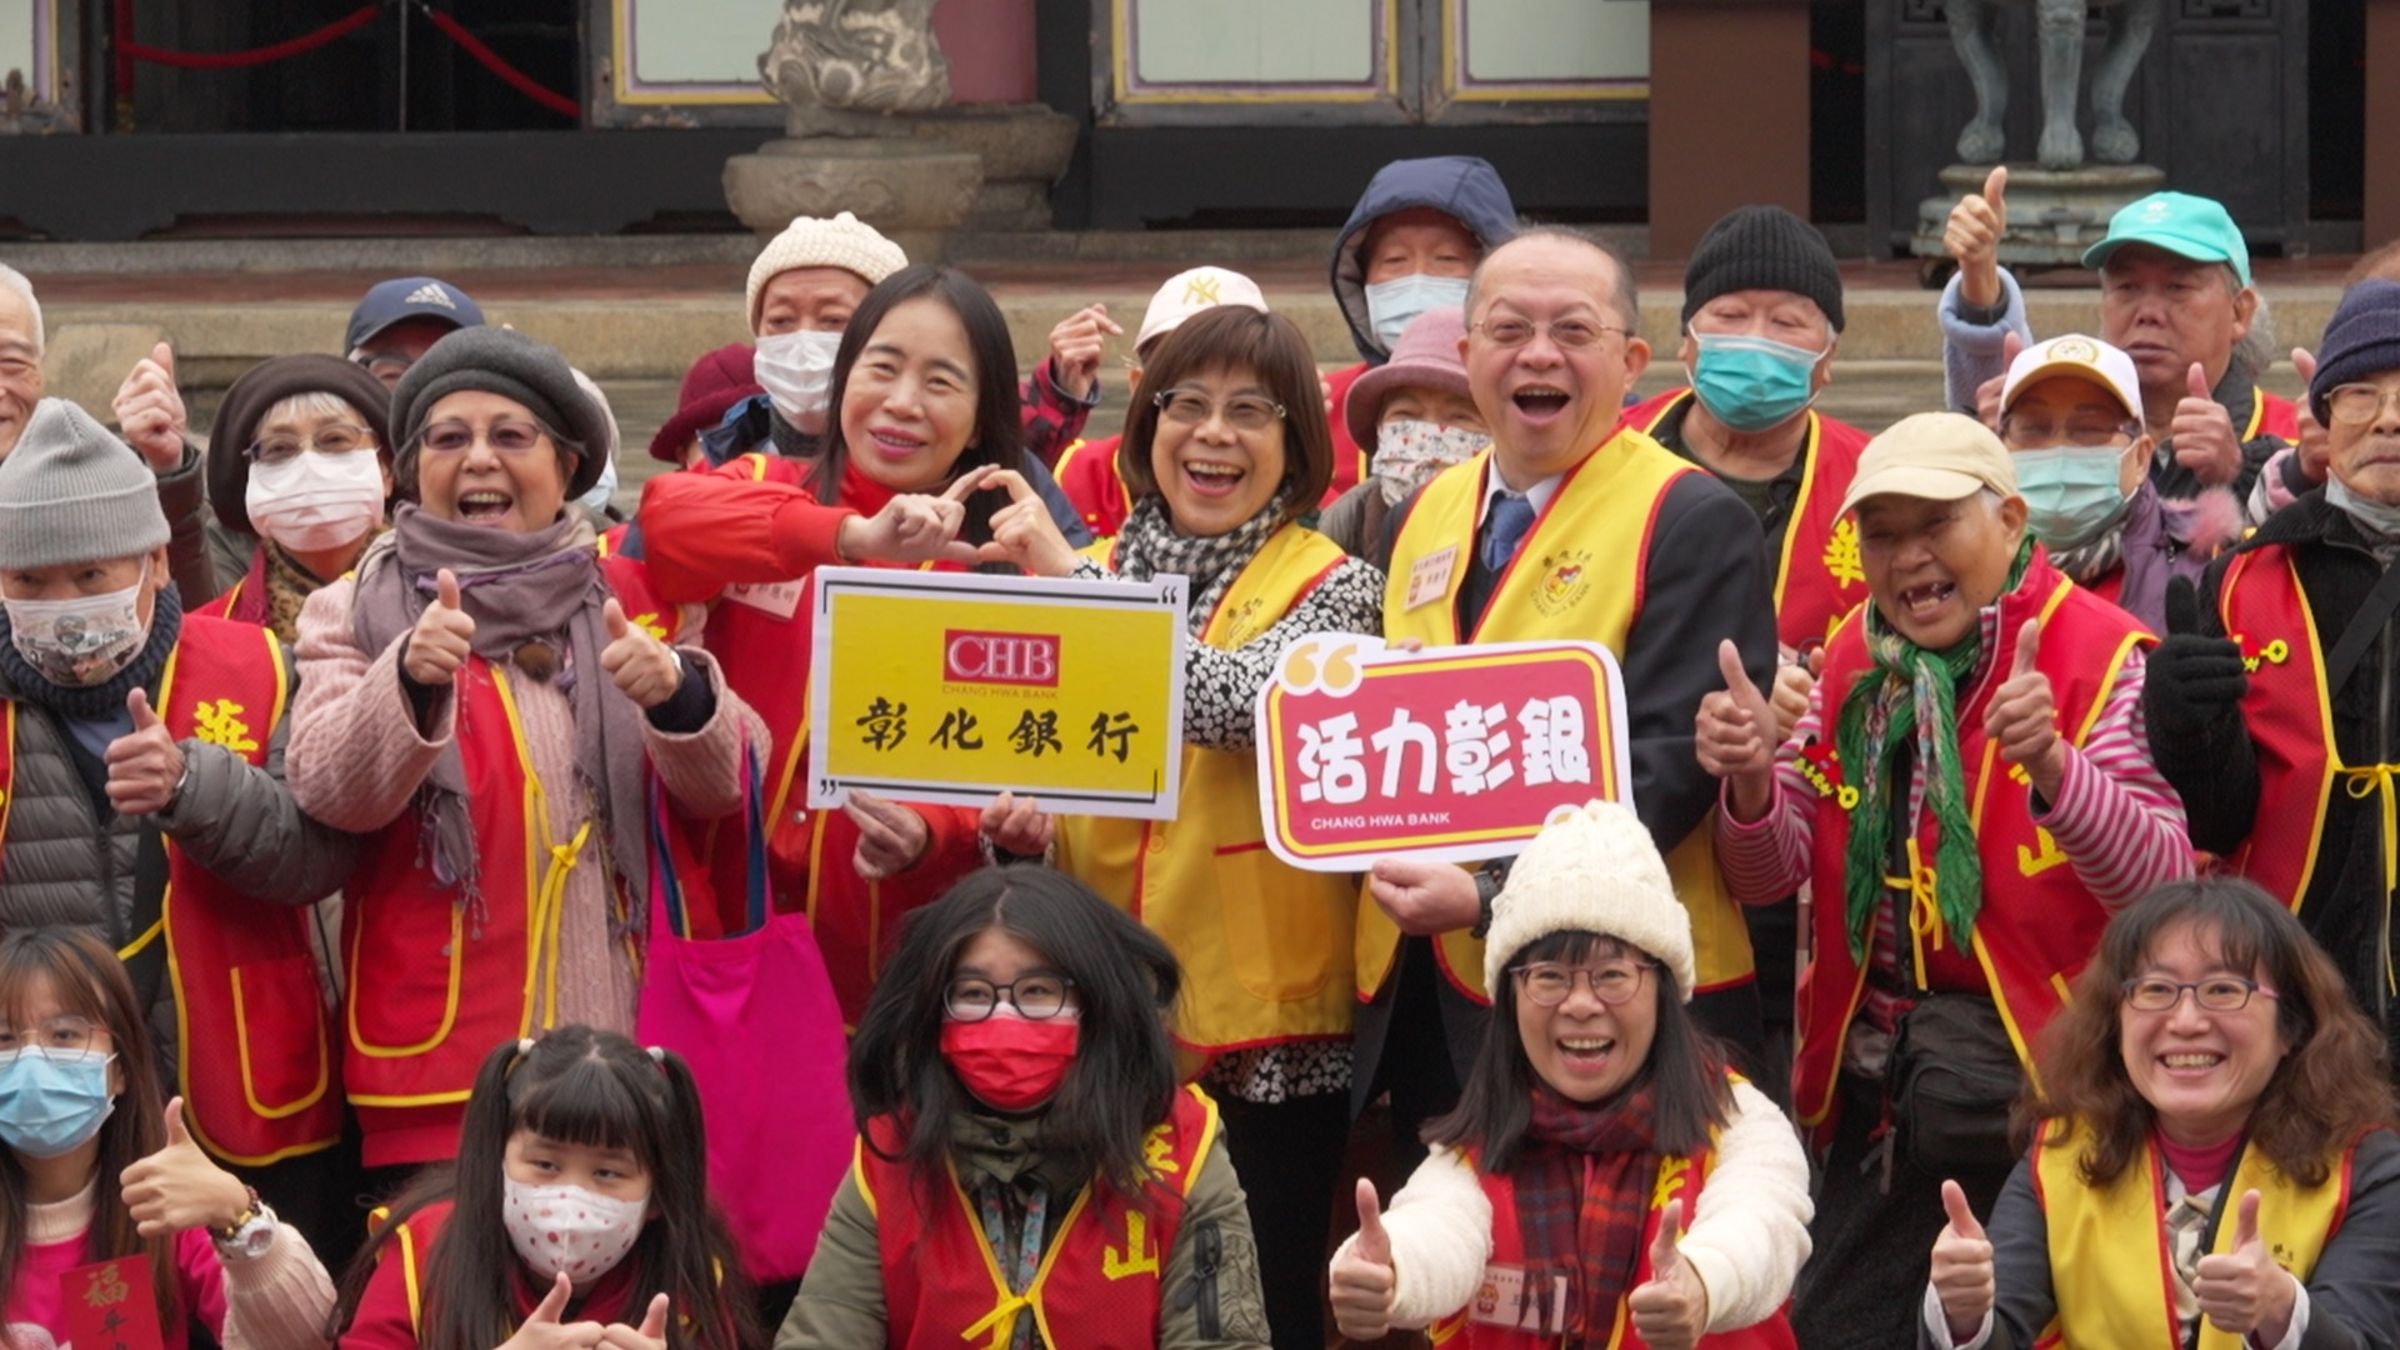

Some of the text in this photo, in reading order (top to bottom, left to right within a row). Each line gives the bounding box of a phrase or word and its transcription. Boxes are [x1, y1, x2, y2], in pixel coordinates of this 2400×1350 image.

[948, 635, 1056, 681] CHB
[942, 684, 1057, 700] CHANG HWA BANK
[856, 697, 1139, 763] 彰化銀行
[1298, 695, 1590, 804] 活力彰銀
[1311, 811, 1451, 830] CHANG HWA BANK
[83, 1264, 128, 1307] 福
